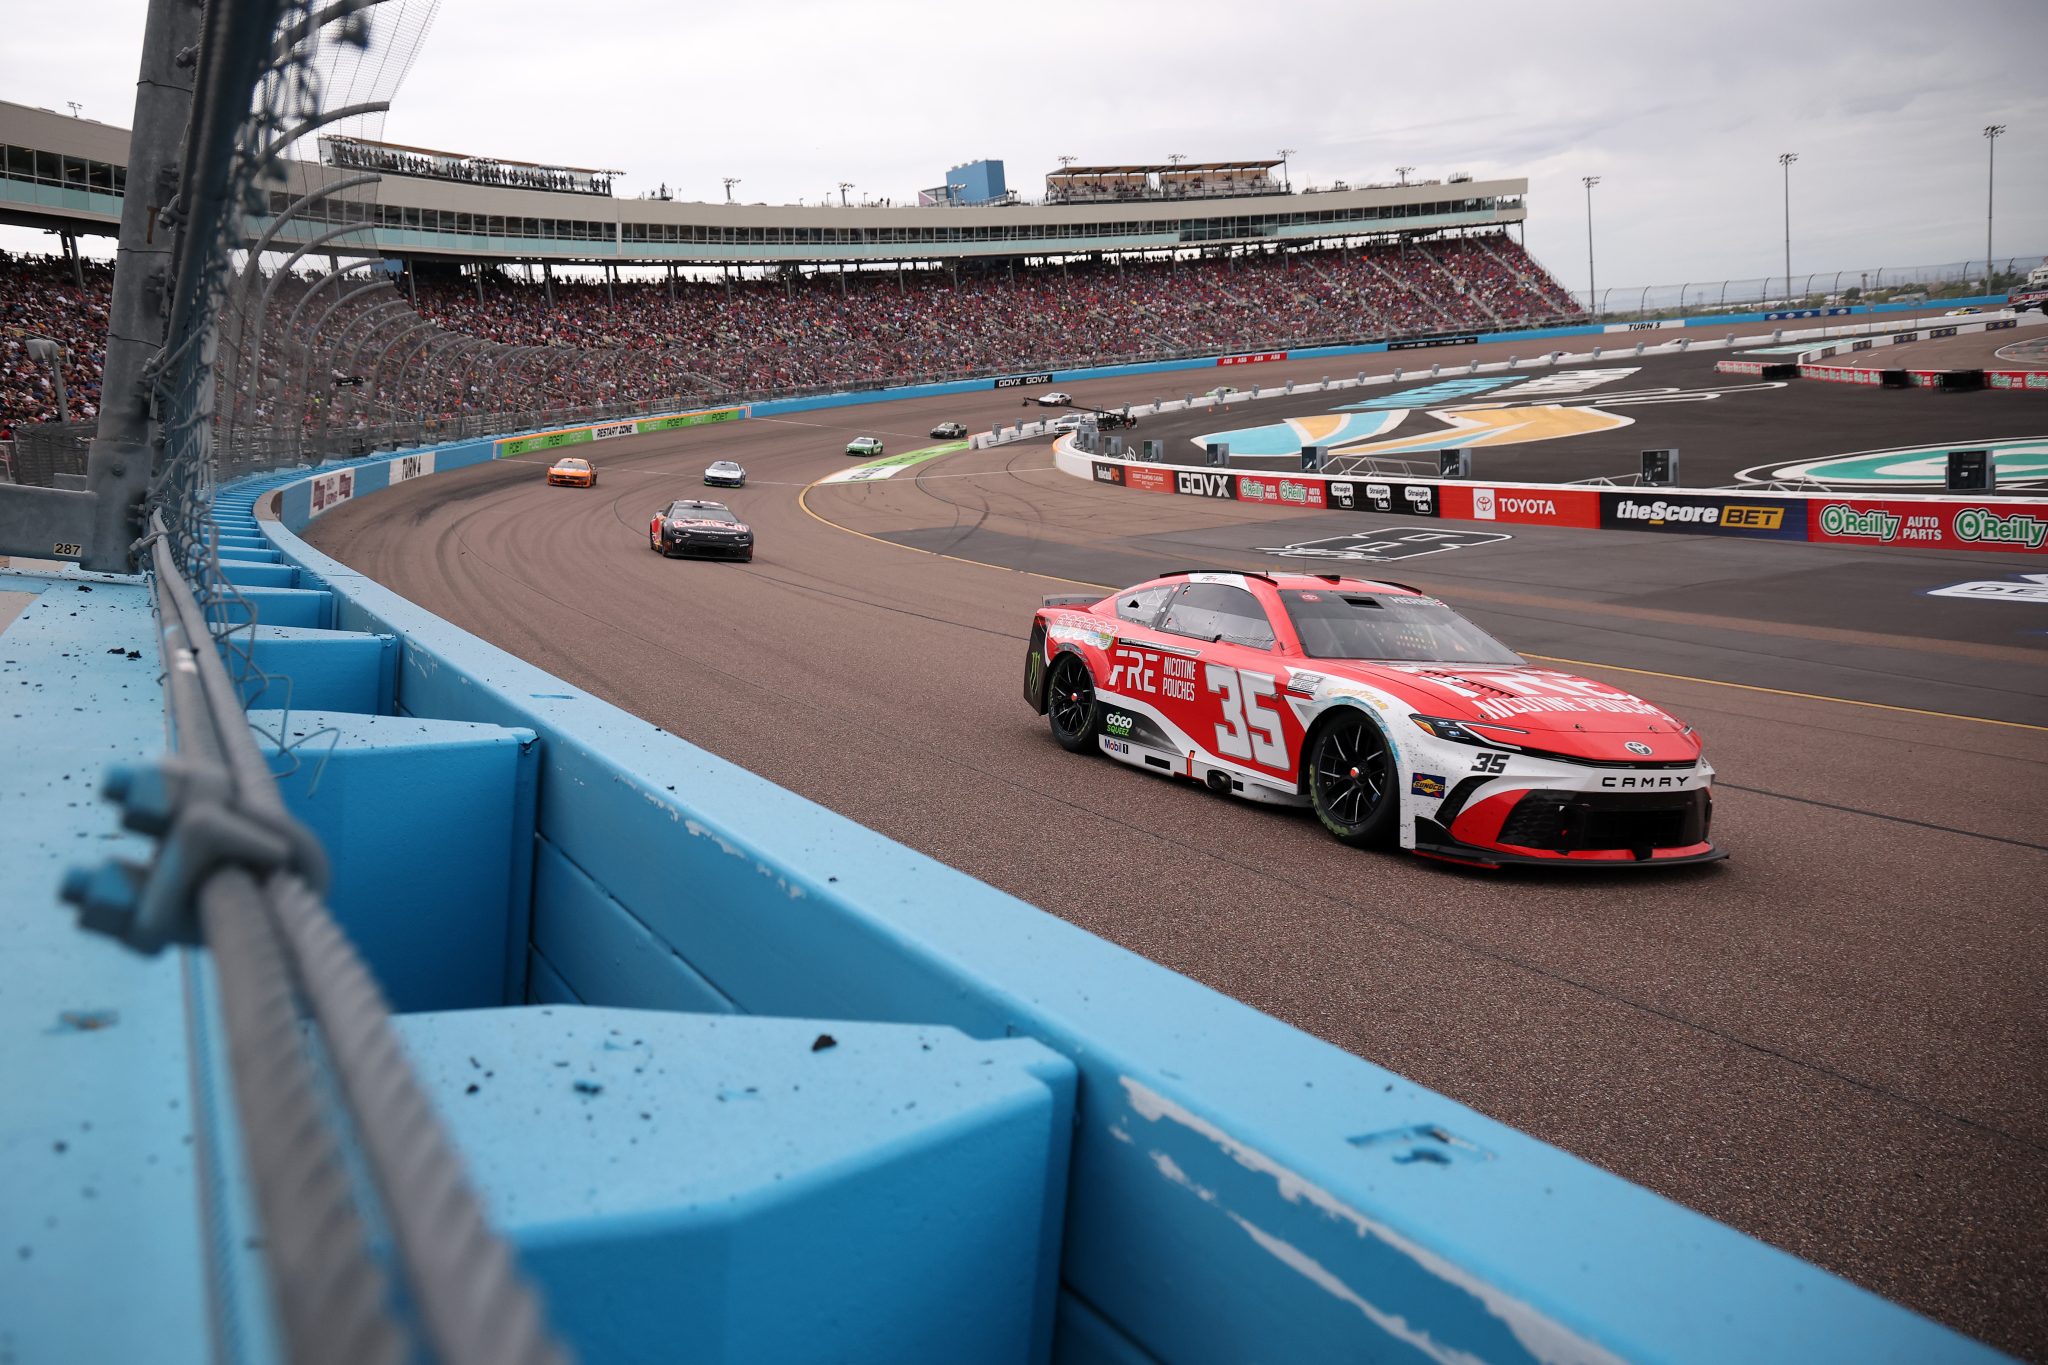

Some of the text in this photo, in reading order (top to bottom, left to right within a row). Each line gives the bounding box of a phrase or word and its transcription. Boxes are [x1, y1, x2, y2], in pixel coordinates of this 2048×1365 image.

[1628, 321, 1661, 331] TURN 3
[998, 378, 1021, 387] GOVX
[1026, 375, 1048, 384] GOVX
[666, 417, 684, 428] POET
[711, 411, 728, 422] POET
[597, 424, 632, 438] RESTART ZONE
[548, 434, 564, 446] POET
[402, 456, 417, 480] TURN
[1178, 472, 1230, 498] GOVX
[1333, 485, 1351, 494] Straight
[1265, 492, 1278, 500] PARTS
[1280, 480, 1307, 504] O'Reilly
[1369, 487, 1388, 496] Straight
[1407, 489, 1428, 498] Straight
[1308, 495, 1322, 503] PARTS
[1342, 497, 1351, 506] Talk
[1378, 500, 1388, 508] Talk
[1417, 502, 1429, 511] Talk
[1499, 498, 1556, 515] TOYOTA
[1616, 500, 1778, 526] theScore BET
[1822, 504, 1900, 541] O'Reilly
[1906, 516, 1939, 528] AUTO
[1956, 508, 2048, 545] O'Reilly
[1902, 528, 1942, 541] PARTS
[55, 543, 80, 555] 287
[1108, 649, 1160, 693] FRE
[1163, 656, 1196, 680] NICOTINE
[1162, 677, 1195, 702] POUCHES
[1471, 697, 1588, 719] NICOTINE
[1204, 663, 1290, 772] 35
[1104, 738, 1128, 754] Mobil 1
[1470, 753, 1510, 774] 35
[1413, 781, 1443, 790] SUNOCO
[1602, 776, 1689, 787] CAMRY
